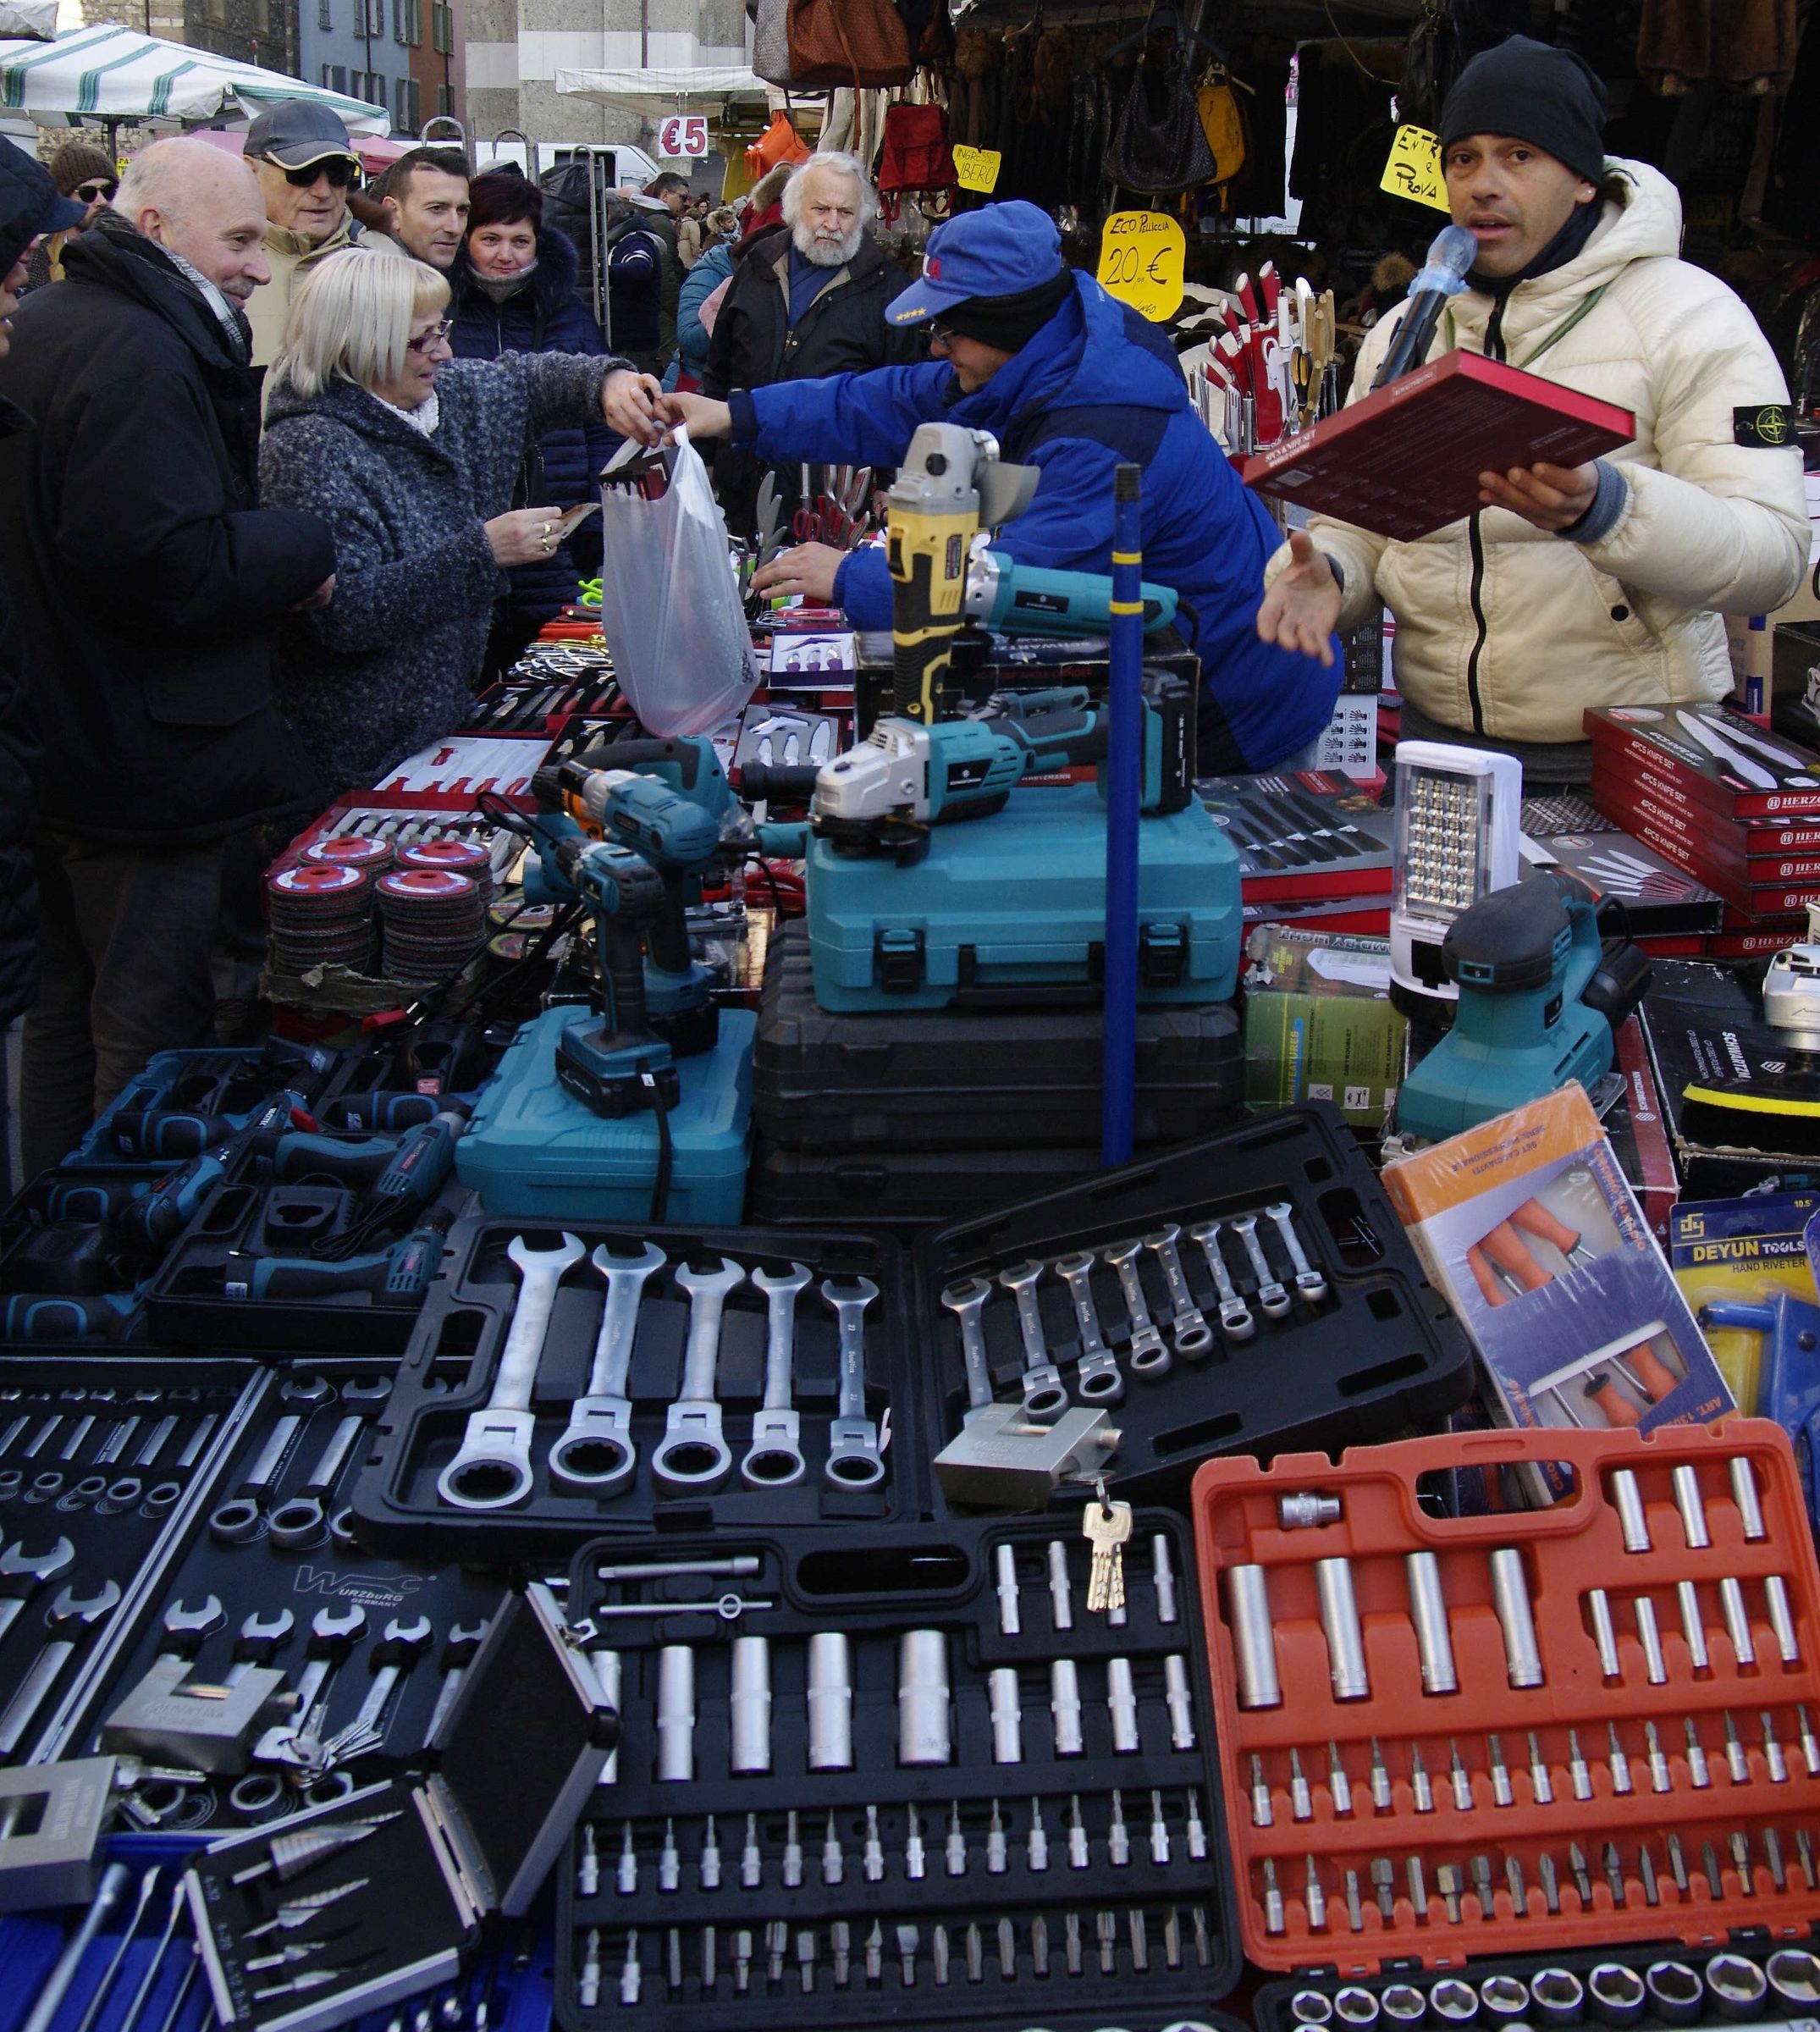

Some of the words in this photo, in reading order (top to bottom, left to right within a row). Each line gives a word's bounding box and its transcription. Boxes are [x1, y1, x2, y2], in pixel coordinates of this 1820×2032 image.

[661, 119, 706, 155] €5
[1398, 128, 1441, 159] ENTR
[959, 162, 995, 184] IBERO
[1110, 218, 1136, 234] ECO
[1146, 247, 1172, 284] €
[994, 641, 1091, 651] SCHWARTZ
[1279, 931, 1330, 945] LIGHT
[1288, 1031, 1299, 1081] FEATURES
[1694, 1241, 1759, 1262] DEYUN
[1762, 1241, 1806, 1254] TOOLS
[1732, 1262, 1760, 1273] HAND
[1763, 1258, 1806, 1270] RIVETER
